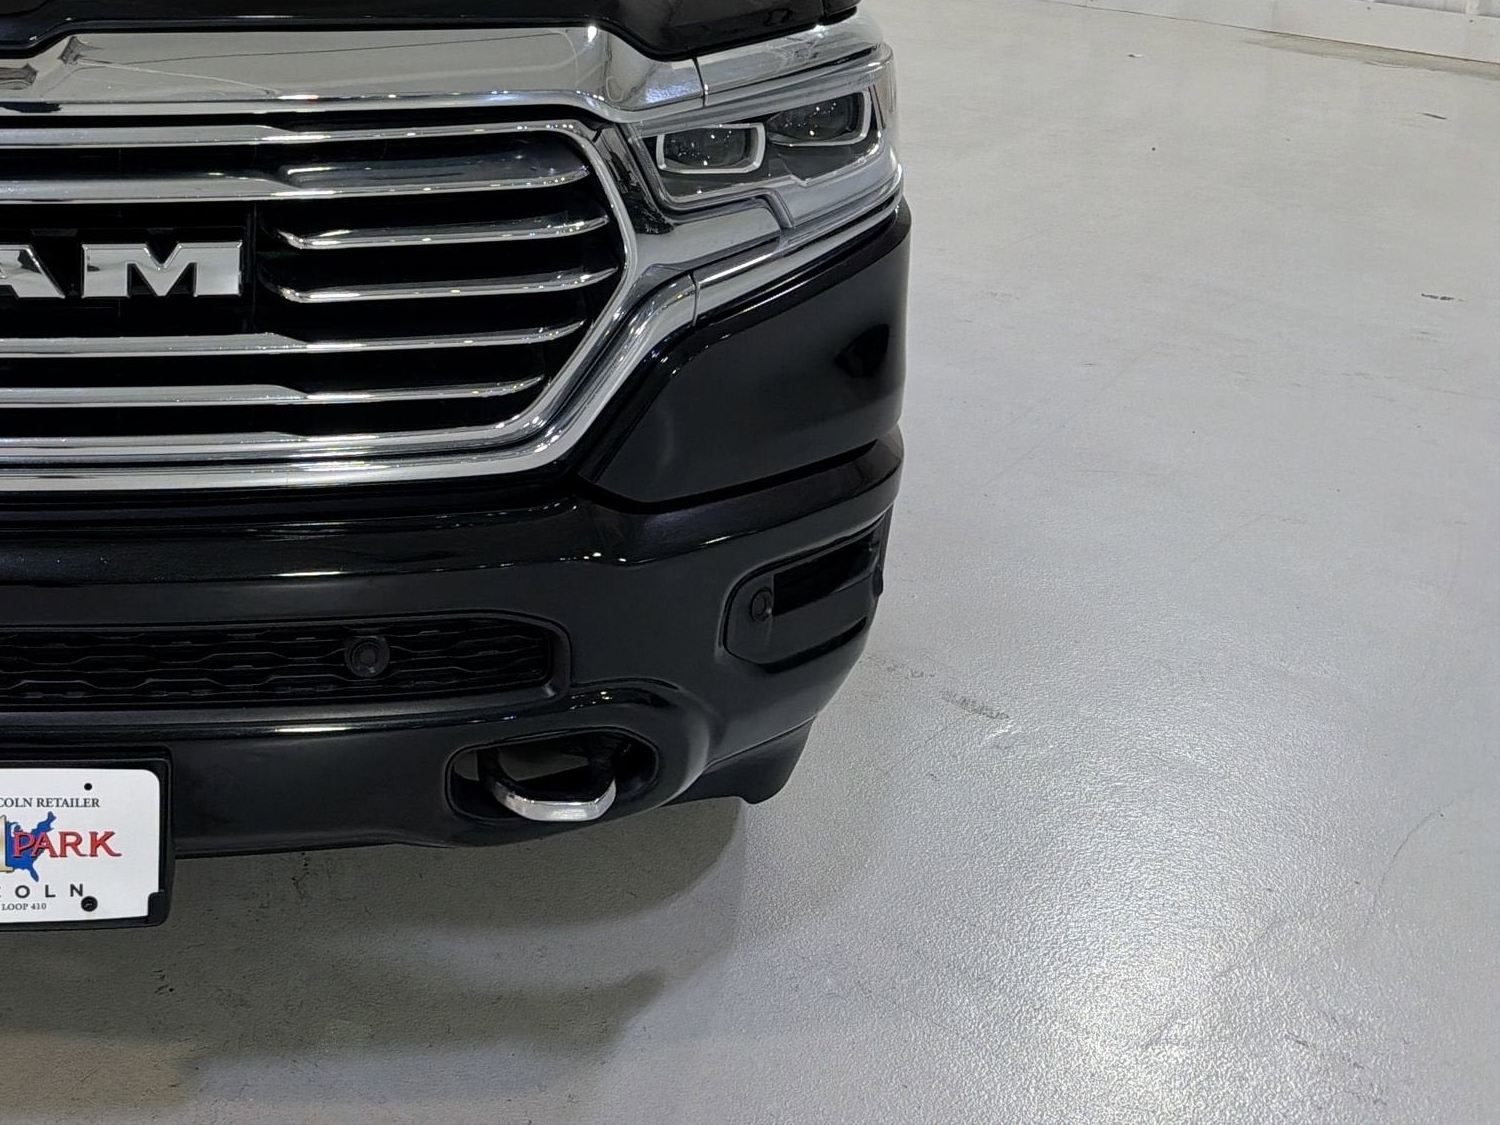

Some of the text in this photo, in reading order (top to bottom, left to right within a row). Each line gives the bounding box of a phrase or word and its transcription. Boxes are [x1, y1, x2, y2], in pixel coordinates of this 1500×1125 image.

[36, 798, 100, 808] RETAILER
[13, 831, 123, 859] PARK
[1, 903, 29, 911] LOOP
[30, 902, 47, 911] 410
